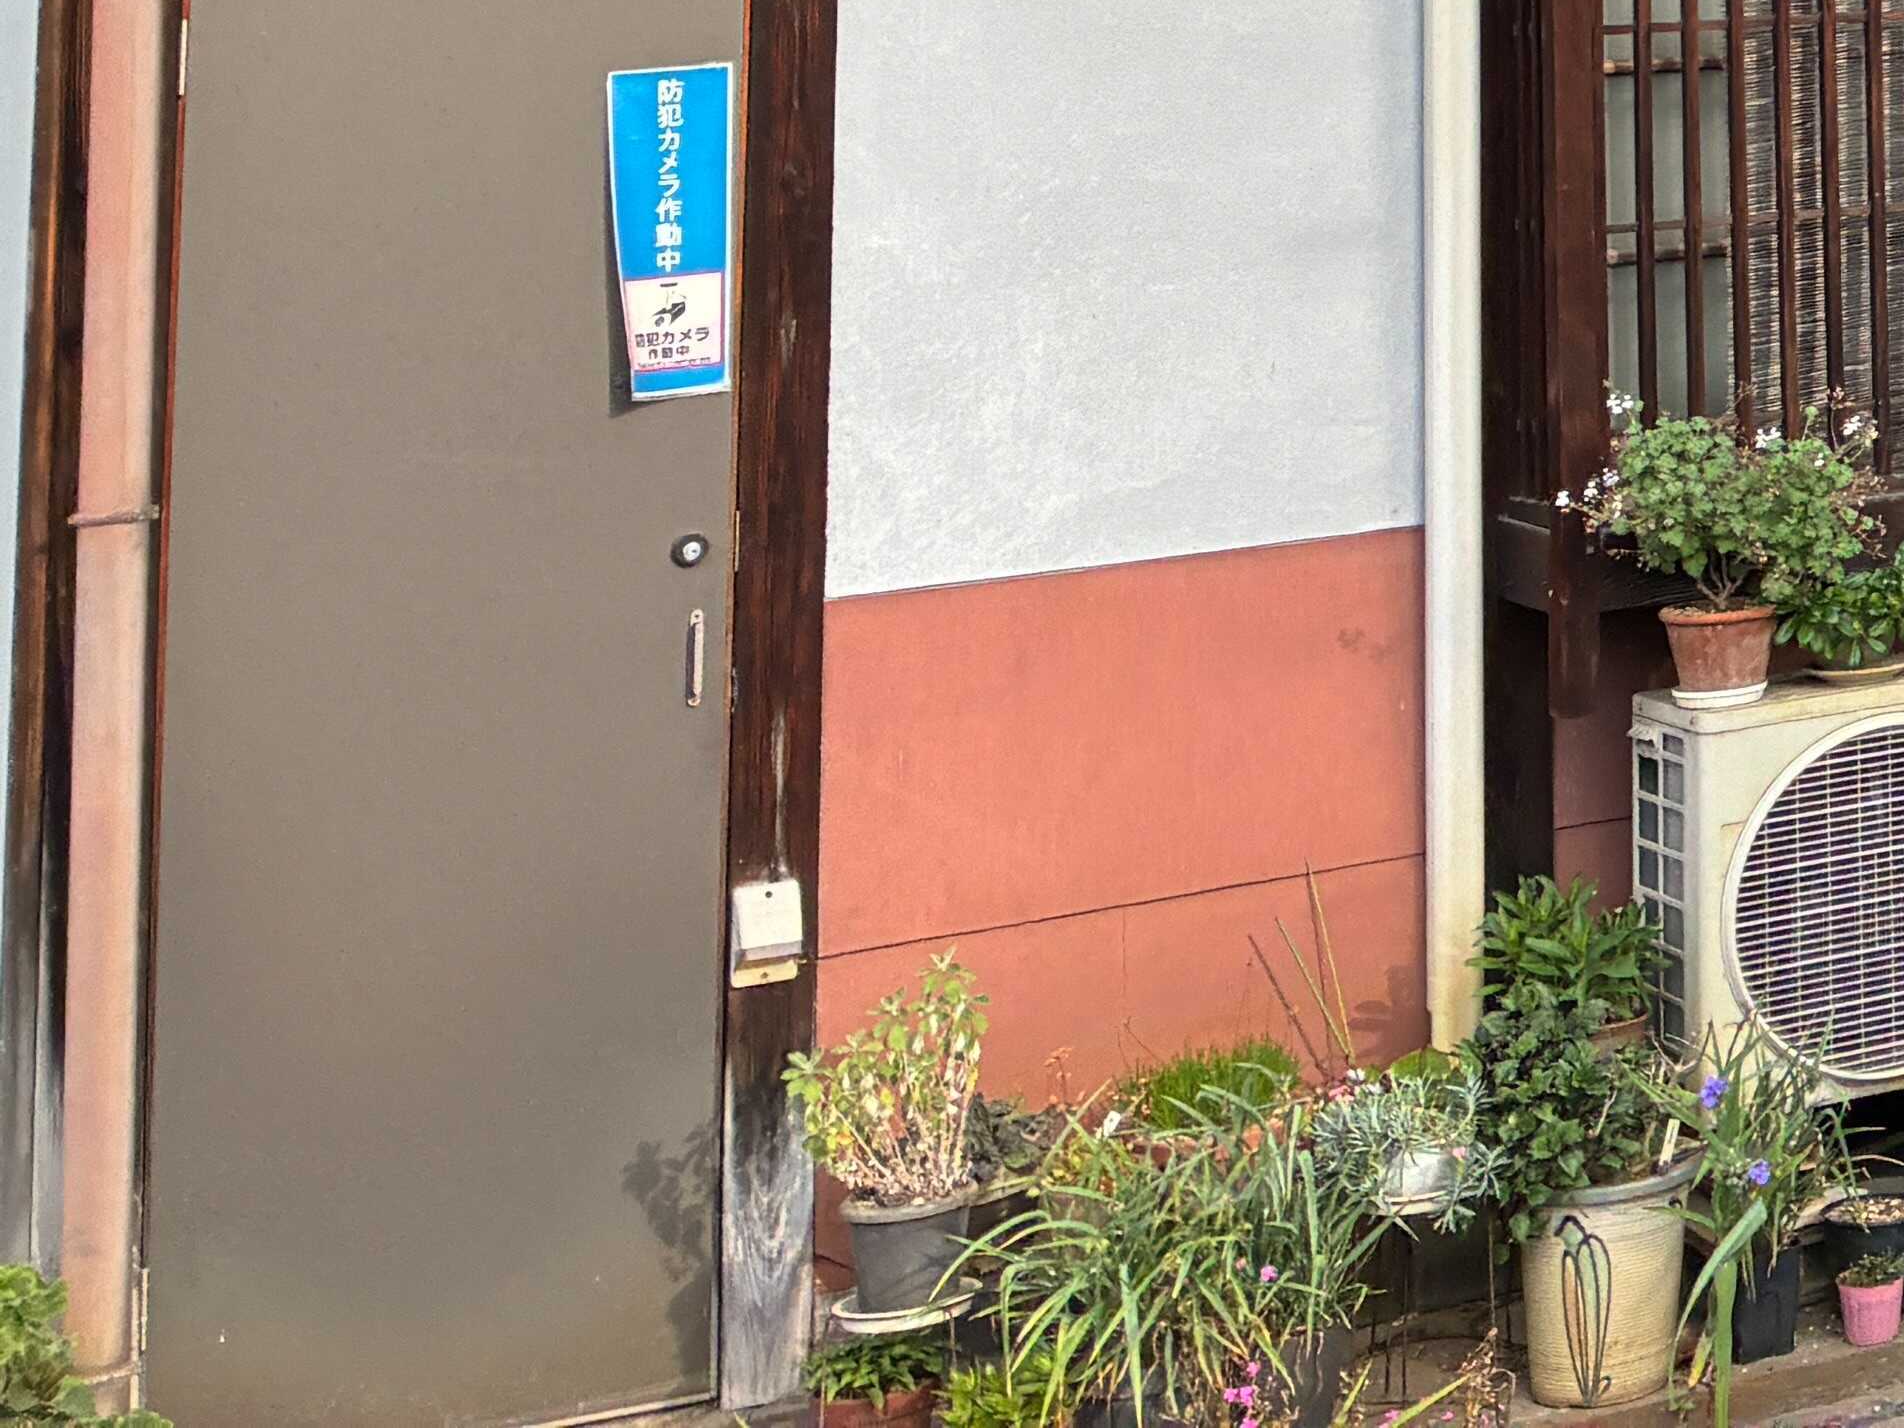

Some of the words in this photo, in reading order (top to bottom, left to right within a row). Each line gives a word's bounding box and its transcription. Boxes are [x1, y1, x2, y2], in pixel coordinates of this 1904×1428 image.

[654, 78, 686, 273] 防犯カメラ作動中
